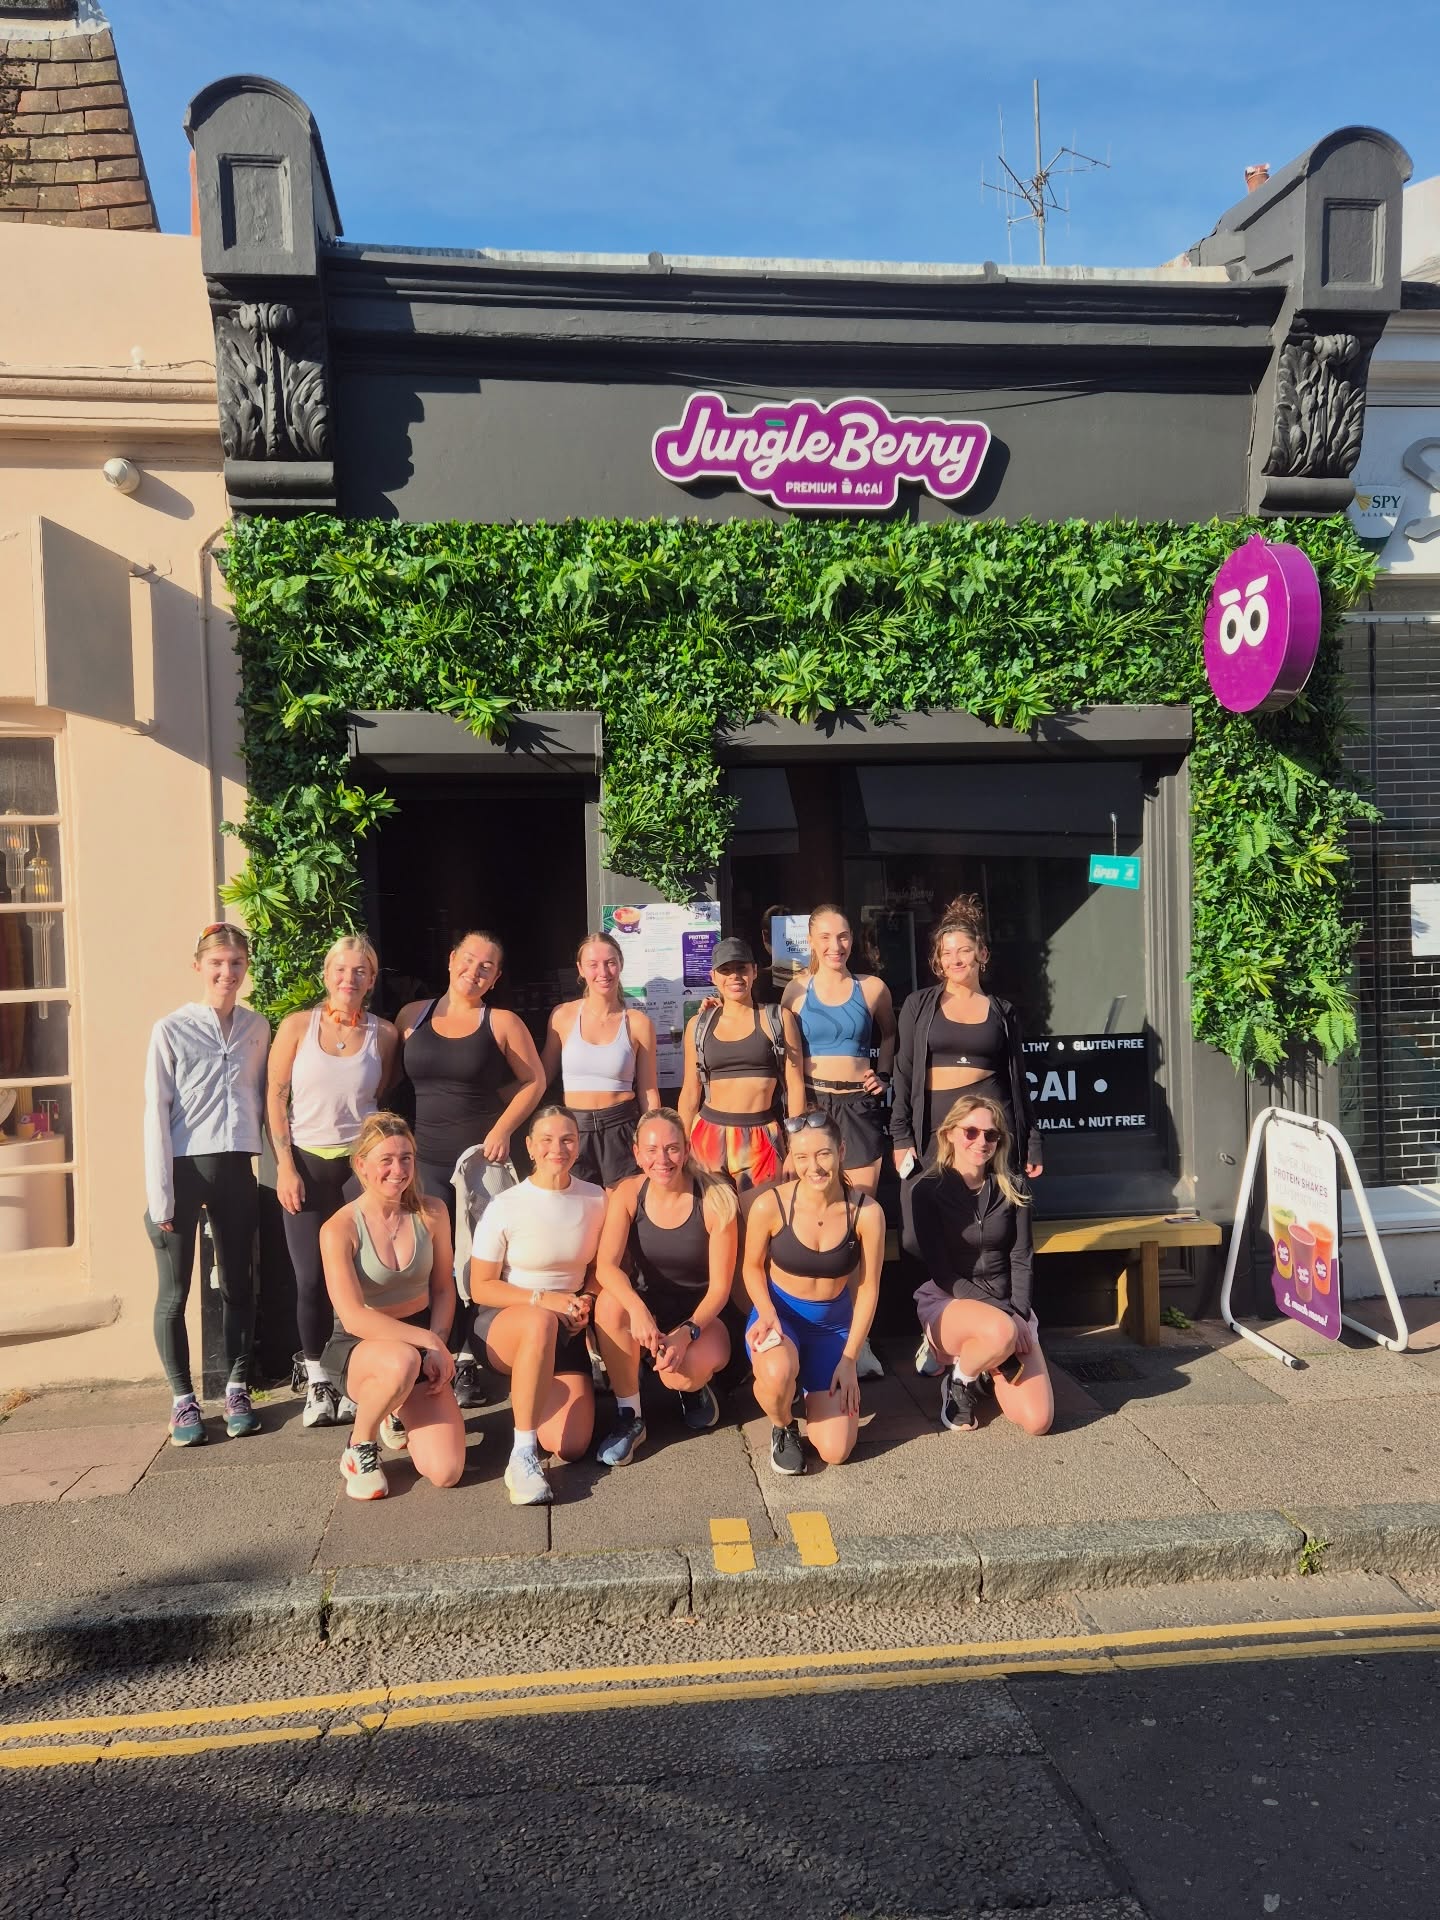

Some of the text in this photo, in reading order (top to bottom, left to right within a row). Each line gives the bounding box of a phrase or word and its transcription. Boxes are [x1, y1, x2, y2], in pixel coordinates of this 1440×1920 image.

[667, 408, 977, 484] Jungle Berry
[785, 481, 837, 494] PREMIUM
[1372, 495, 1401, 509] SPY
[1022, 1038, 1145, 1053] LTHY GLUTEN FREE
[1088, 1116, 1114, 1128] NUT
[1115, 1114, 1146, 1127] FREE
[1273, 1167, 1300, 1185] PROTEIN
[1301, 1178, 1328, 1198] SHAKES
